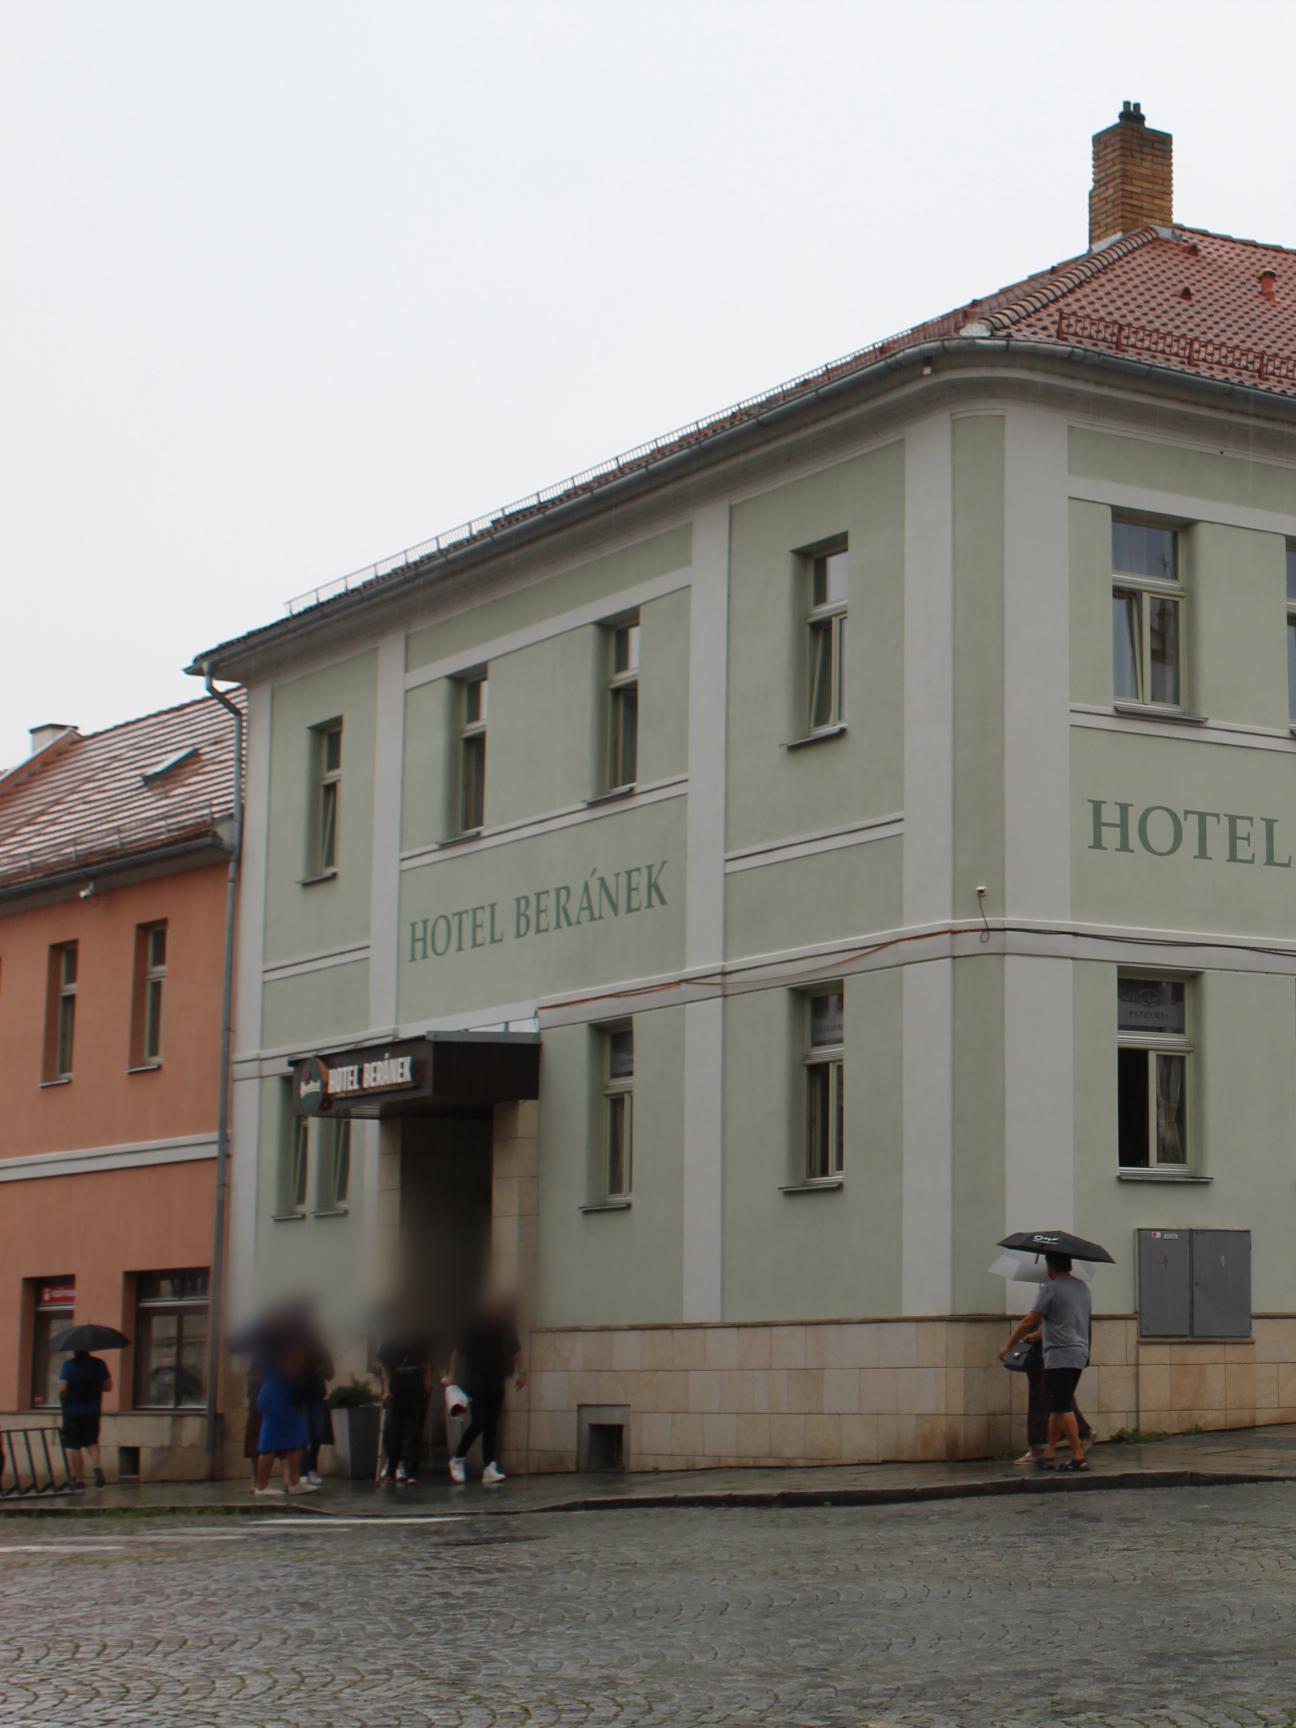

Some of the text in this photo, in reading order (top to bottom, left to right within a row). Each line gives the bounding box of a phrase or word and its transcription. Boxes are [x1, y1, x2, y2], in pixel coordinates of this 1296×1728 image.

[1088, 799, 1292, 868] HOTEL
[408, 860, 669, 963] HOTEL BERÁNEK
[328, 1064, 360, 1094] HOTEL
[363, 1053, 413, 1089] BERÁNEK
